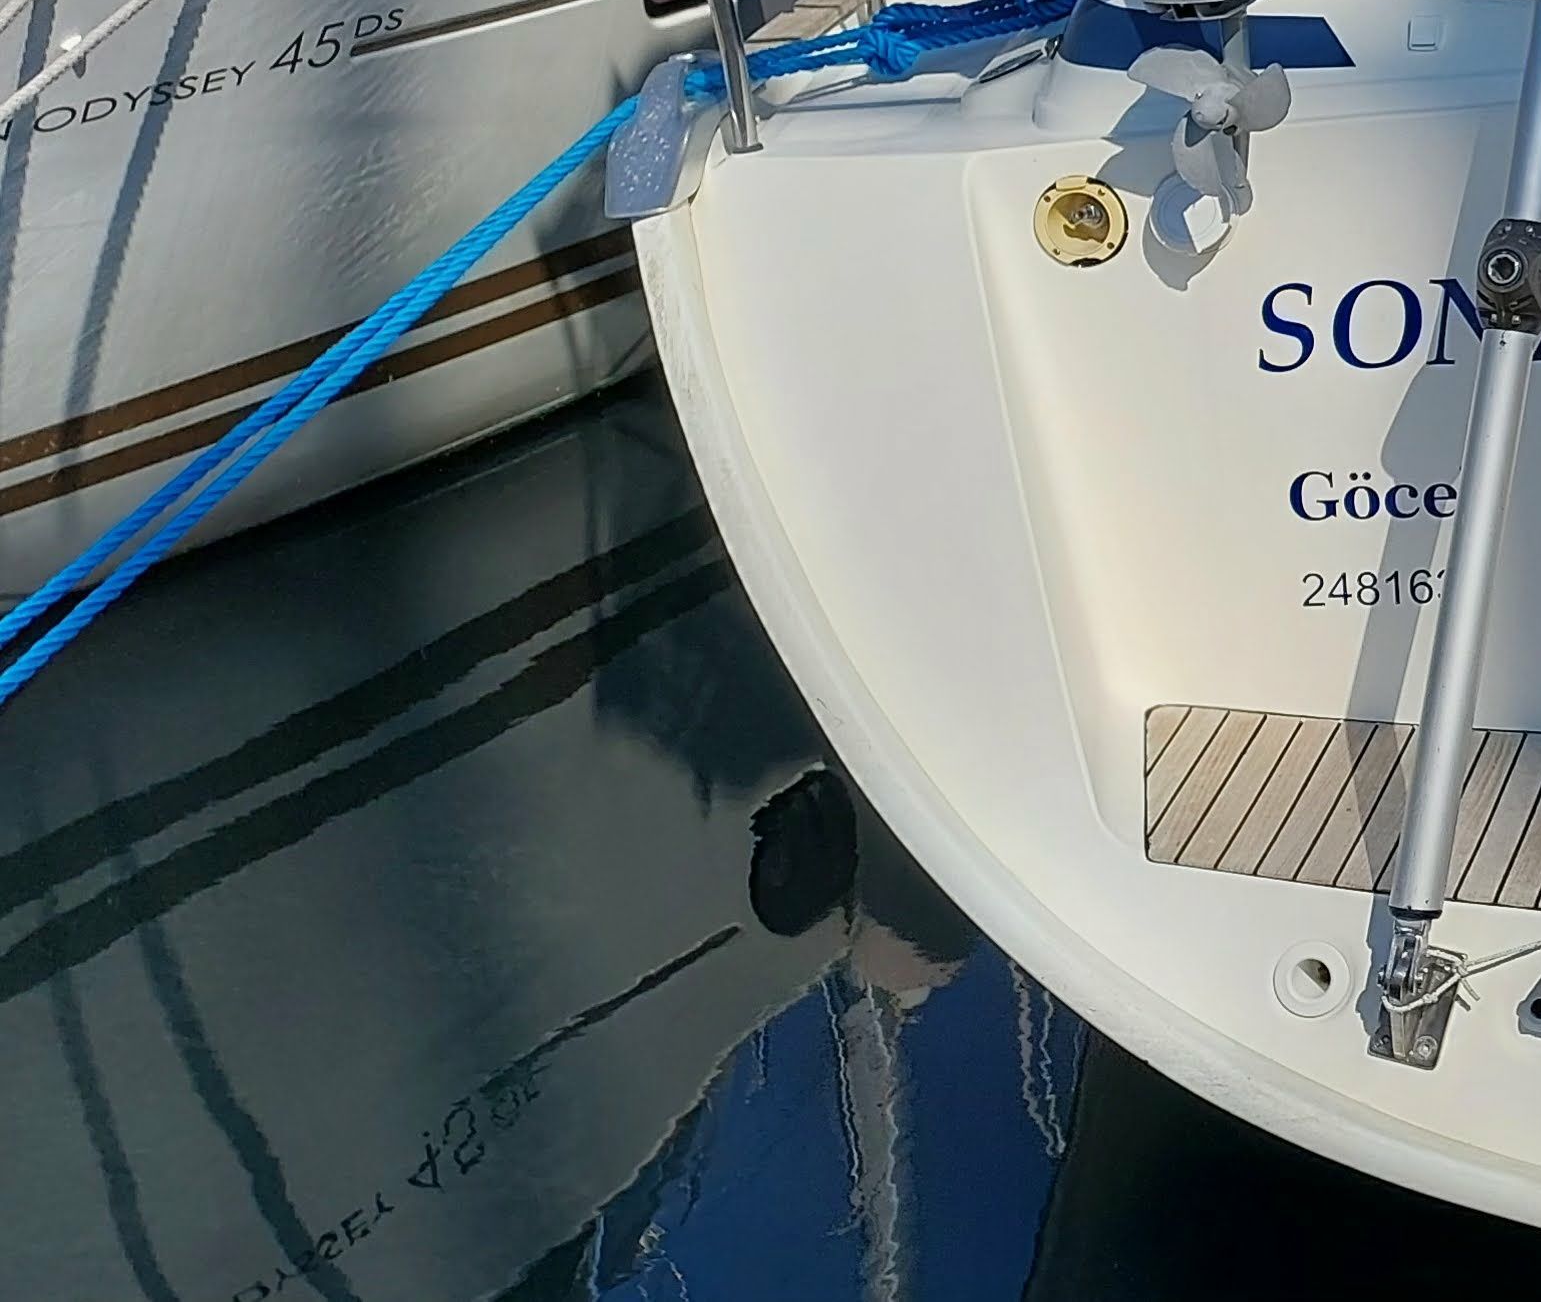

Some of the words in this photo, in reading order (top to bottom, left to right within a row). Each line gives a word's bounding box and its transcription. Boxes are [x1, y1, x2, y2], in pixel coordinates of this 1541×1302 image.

[33, 60, 256, 133] ODYSSEY
[269, 21, 345, 75] 45
[353, 7, 405, 39] DS
[1289, 471, 1458, 521] Göce
